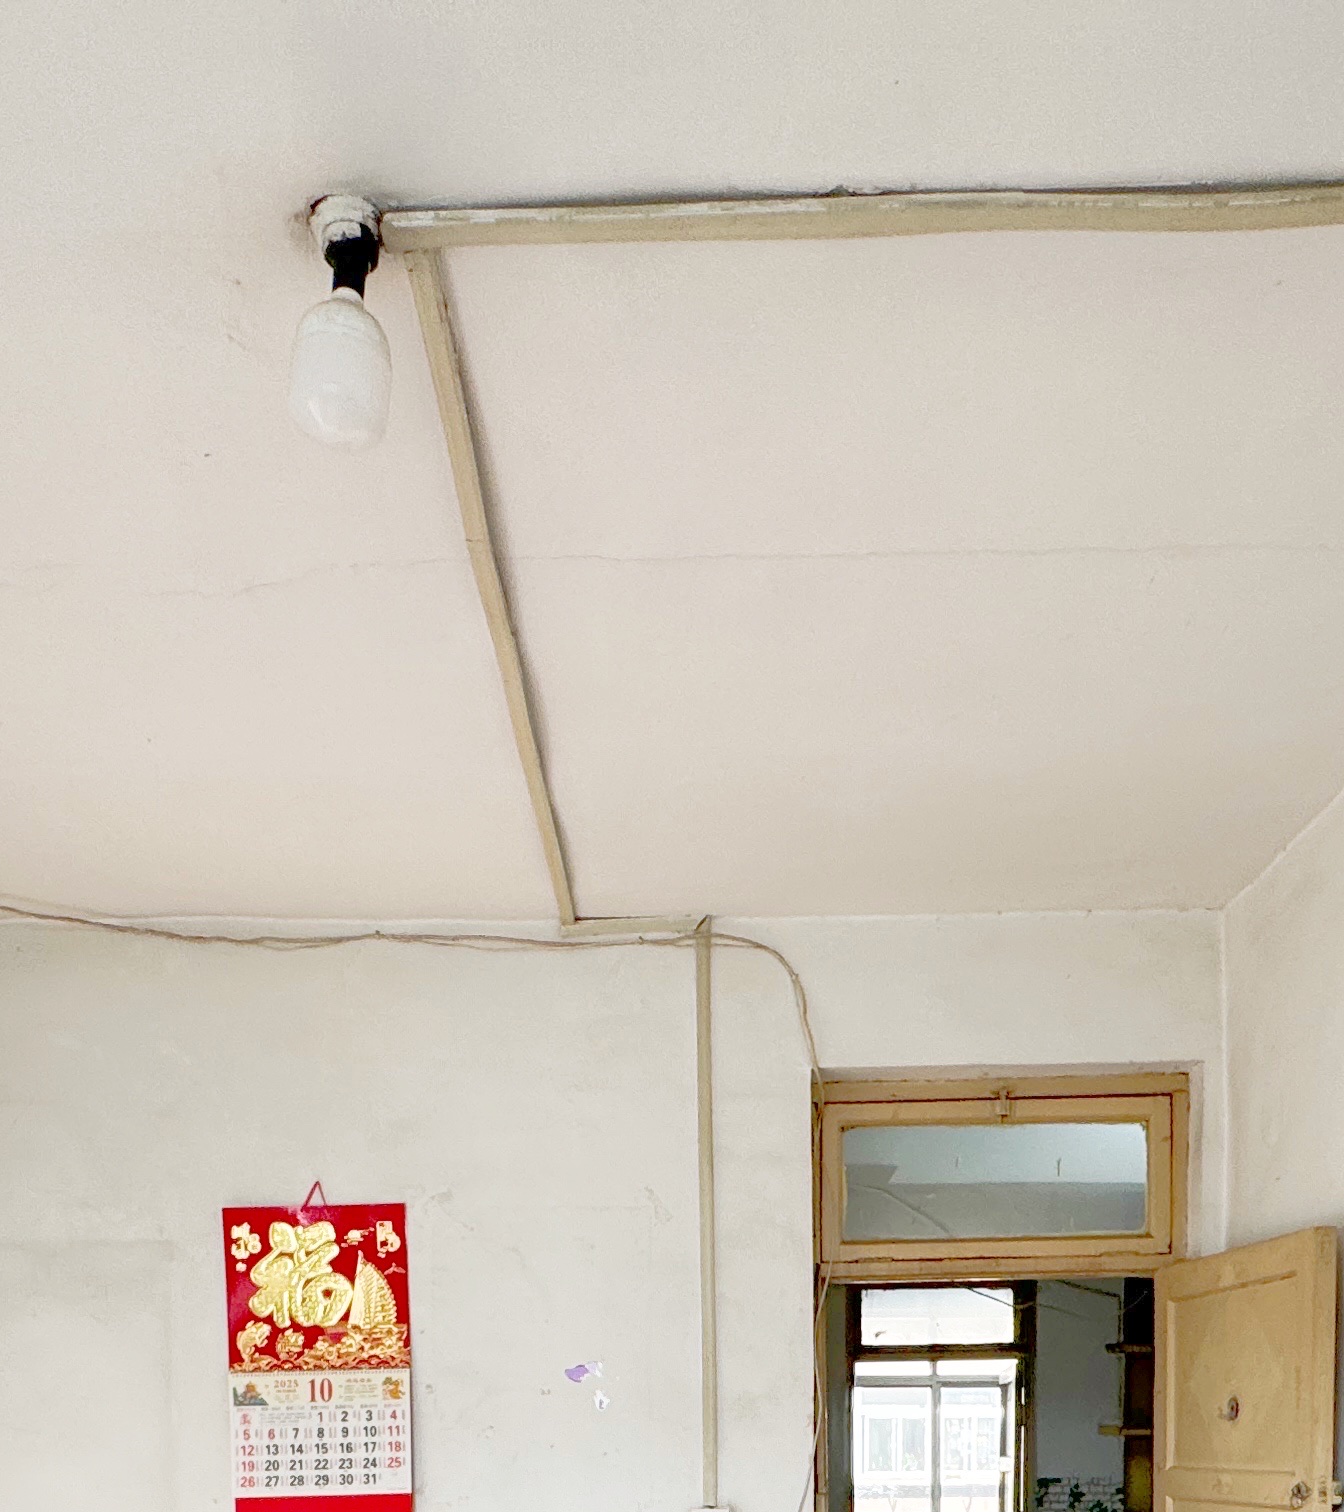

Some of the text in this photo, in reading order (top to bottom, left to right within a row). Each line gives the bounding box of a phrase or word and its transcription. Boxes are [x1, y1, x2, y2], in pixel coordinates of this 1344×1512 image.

[248, 1220, 355, 1329] 福
[273, 1379, 299, 1388] 2025
[308, 1378, 333, 1402] 10
[317, 1411, 323, 1423] 1
[340, 1410, 349, 1422] 2
[365, 1409, 373, 1422] 3
[389, 1409, 398, 1420] 4
[243, 1425, 400, 1441] 5 6 7 8 9 10 11
[240, 1440, 402, 1456] 12 13 14 15 16 17 18
[241, 1456, 402, 1473] 19 20 21 22 23 24 25
[240, 1473, 377, 1488] 26 27 28 29 30 31
